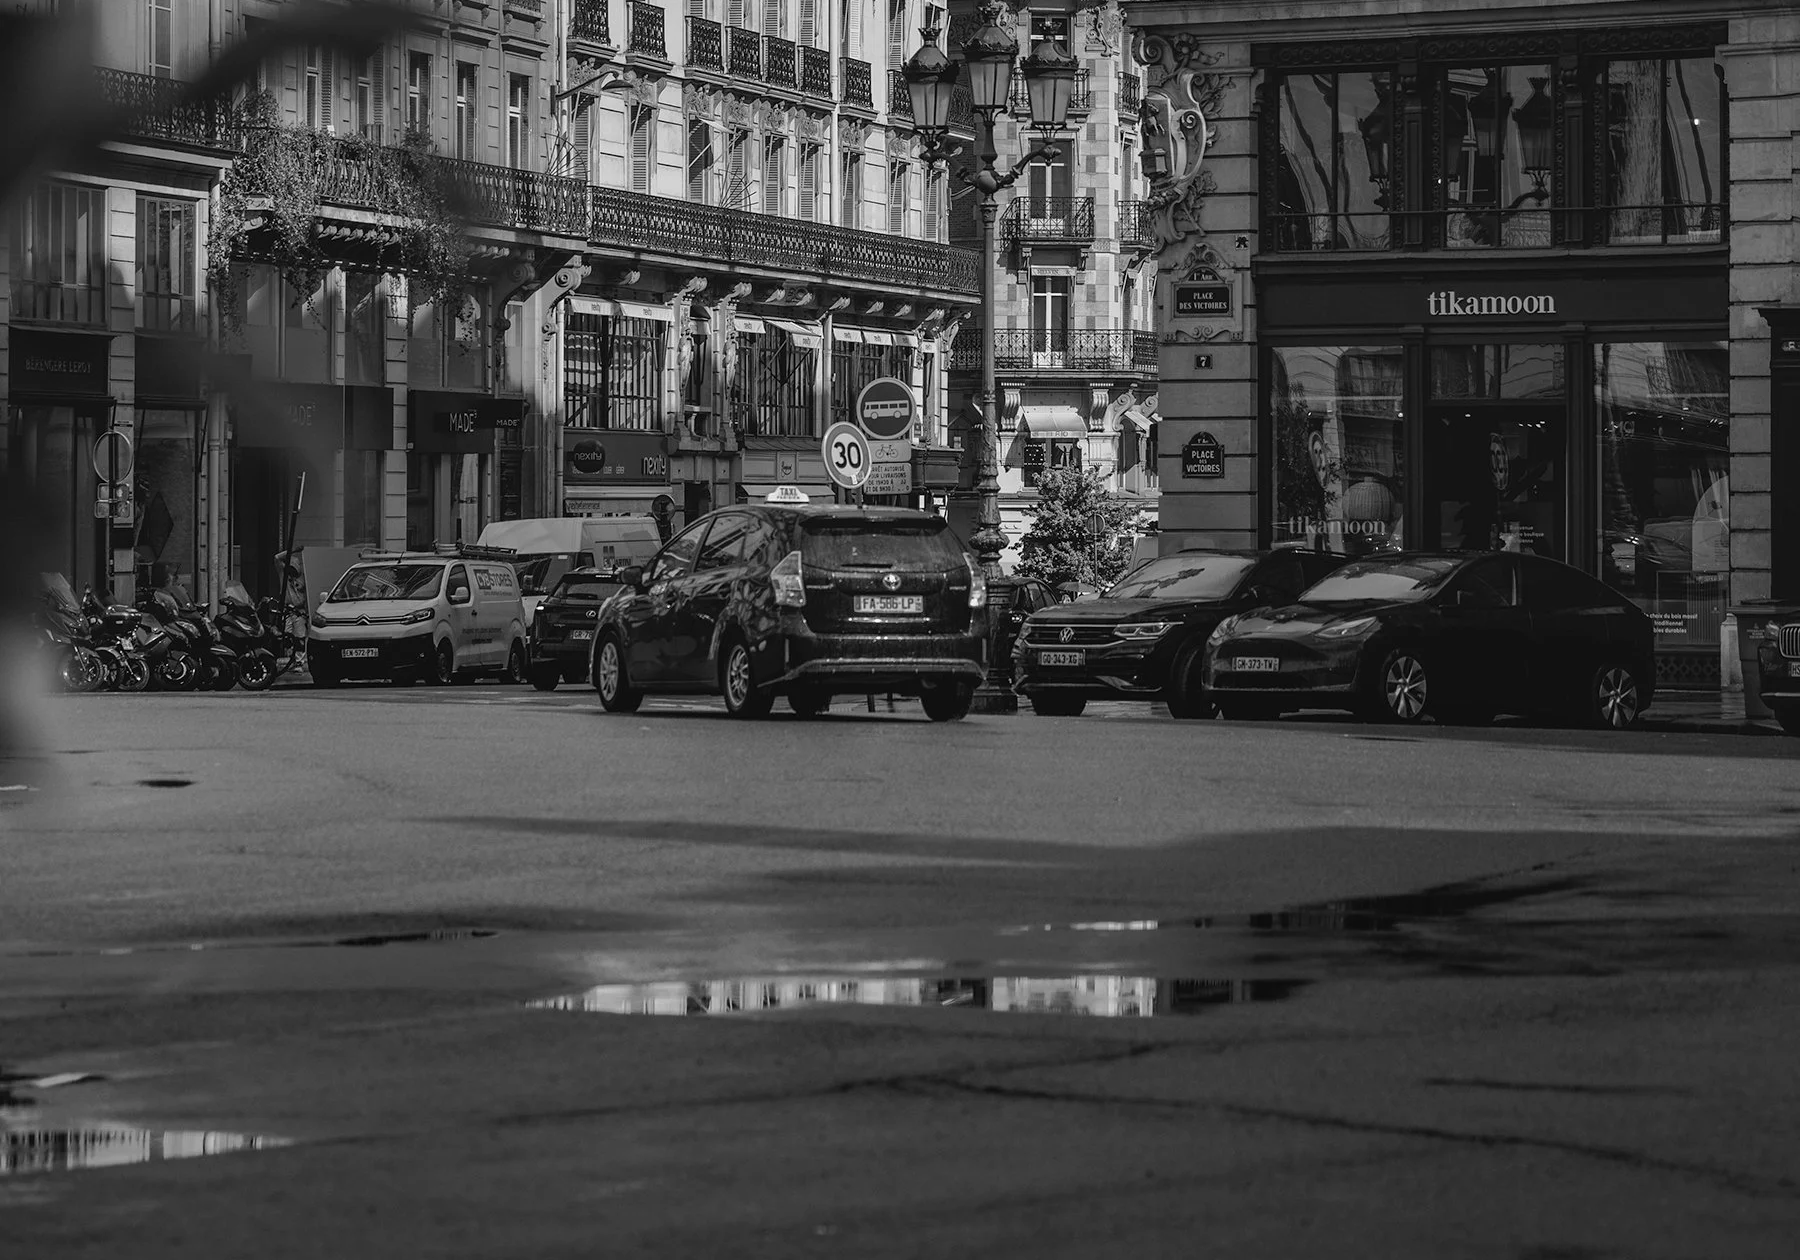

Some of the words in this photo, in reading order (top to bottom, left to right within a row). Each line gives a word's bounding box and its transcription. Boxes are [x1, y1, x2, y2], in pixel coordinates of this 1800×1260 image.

[1193, 292, 1214, 300] PLACE
[1179, 302, 1192, 310] DES
[1194, 302, 1228, 310] VICTOIRES
[1427, 291, 1557, 316] tikamoon
[1200, 356, 1207, 367] 7
[575, 451, 603, 461] nexity
[834, 442, 861, 468] 30
[1192, 450, 1215, 459] PLACE
[643, 454, 667, 475] nexity
[1186, 464, 1221, 473] VICTOIRES
[779, 487, 798, 496] TAXI
[1289, 515, 1386, 535] tikamoon
[863, 598, 914, 609] FA-586-LP
